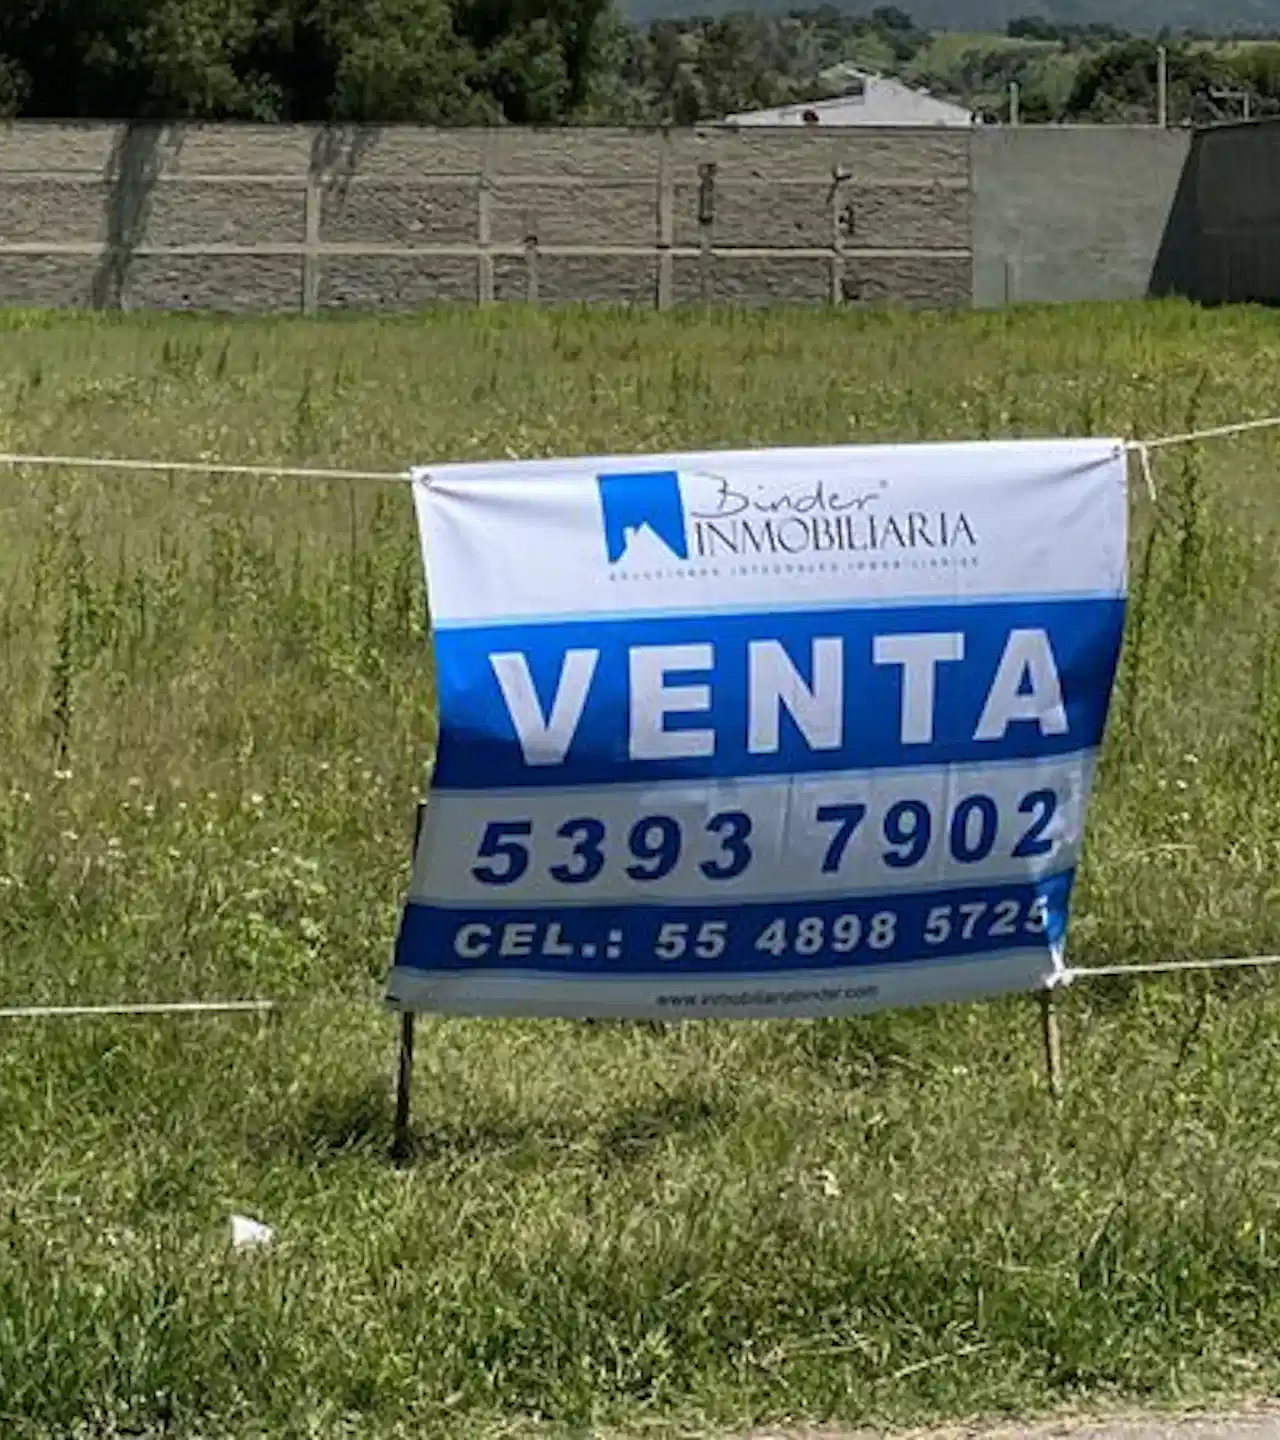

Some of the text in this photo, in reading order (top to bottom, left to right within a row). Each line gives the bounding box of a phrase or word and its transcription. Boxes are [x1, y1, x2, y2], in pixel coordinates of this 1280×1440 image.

[690, 471, 880, 519] Binder
[693, 511, 978, 557] INMOBILIARIA
[487, 627, 1070, 767] VENTA
[471, 787, 1059, 887] 5393 7902
[453, 921, 624, 959] CEL.:
[654, 920, 728, 959] 55
[755, 910, 899, 957] 4898
